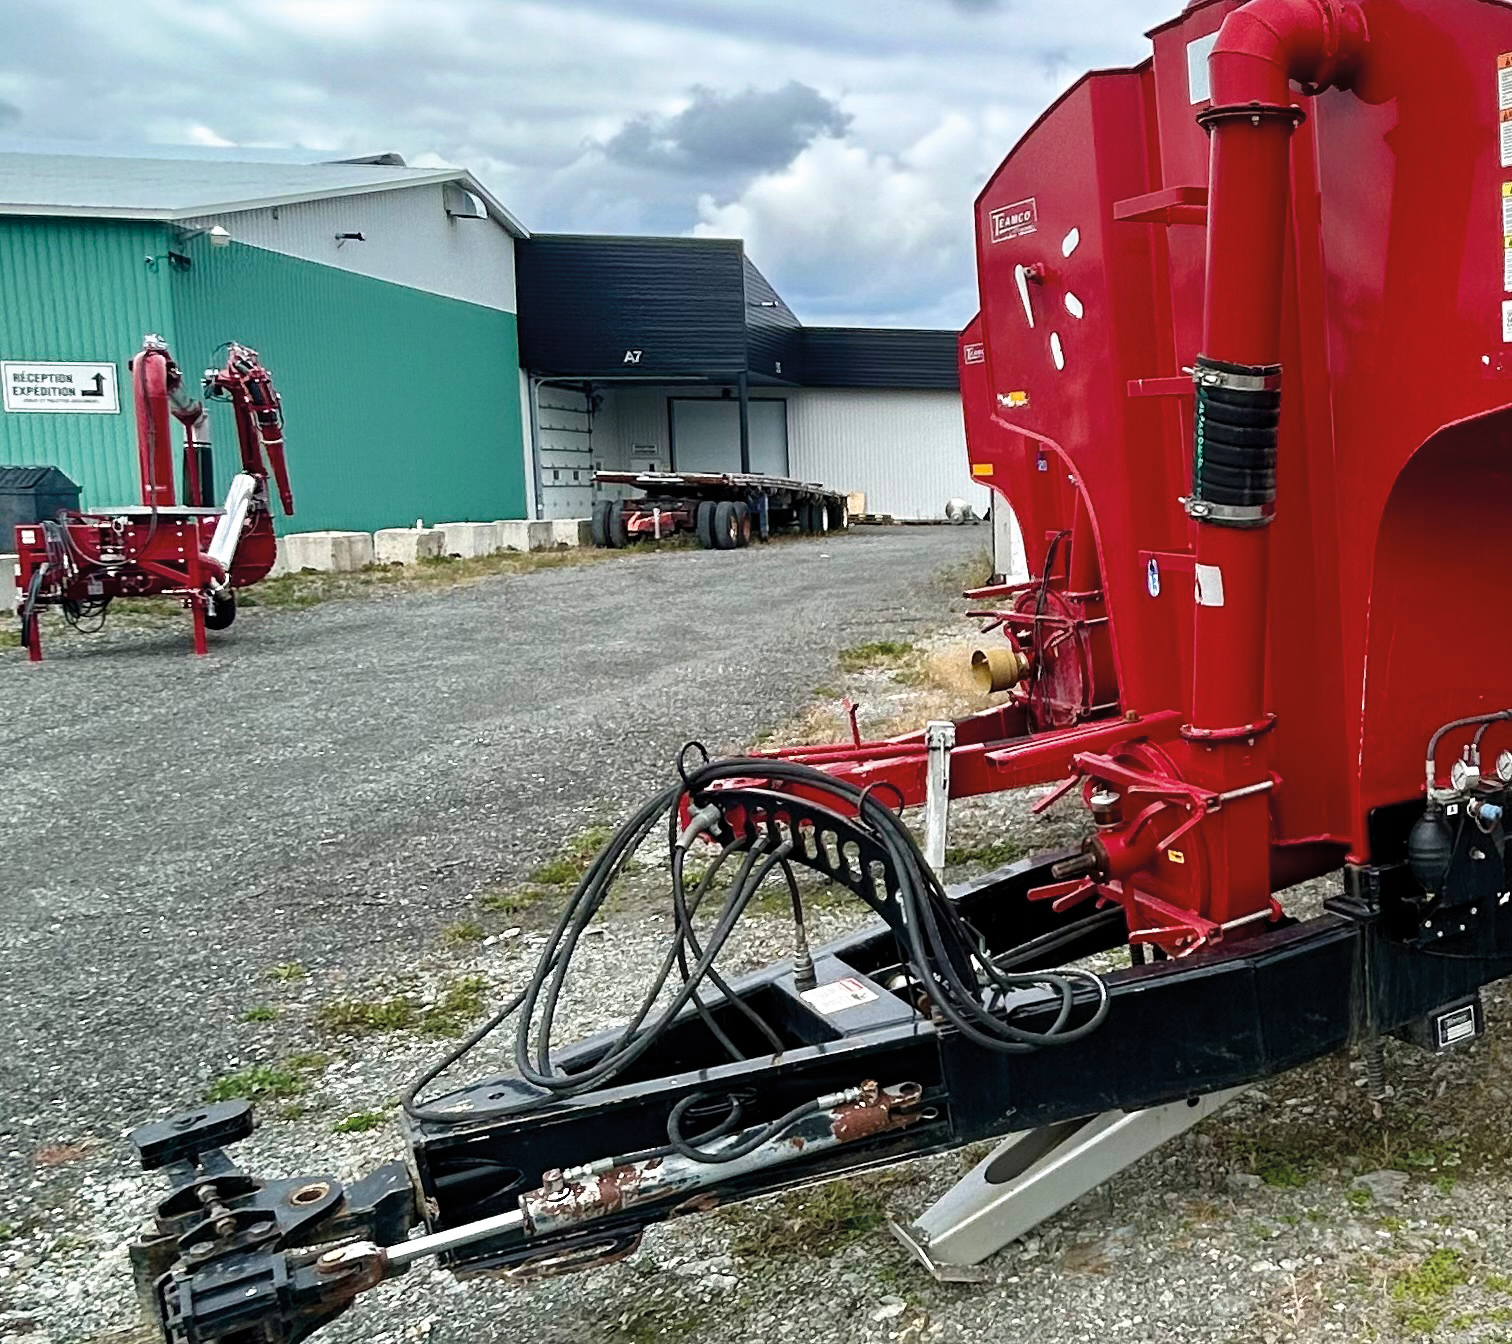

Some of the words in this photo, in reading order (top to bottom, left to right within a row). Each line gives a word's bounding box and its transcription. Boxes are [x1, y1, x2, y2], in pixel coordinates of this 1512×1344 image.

[992, 212, 1031, 236] TEAMCO
[624, 351, 642, 363] A7
[12, 371, 73, 383] RÉCEPTION
[12, 385, 76, 396] EXPÉDITION
